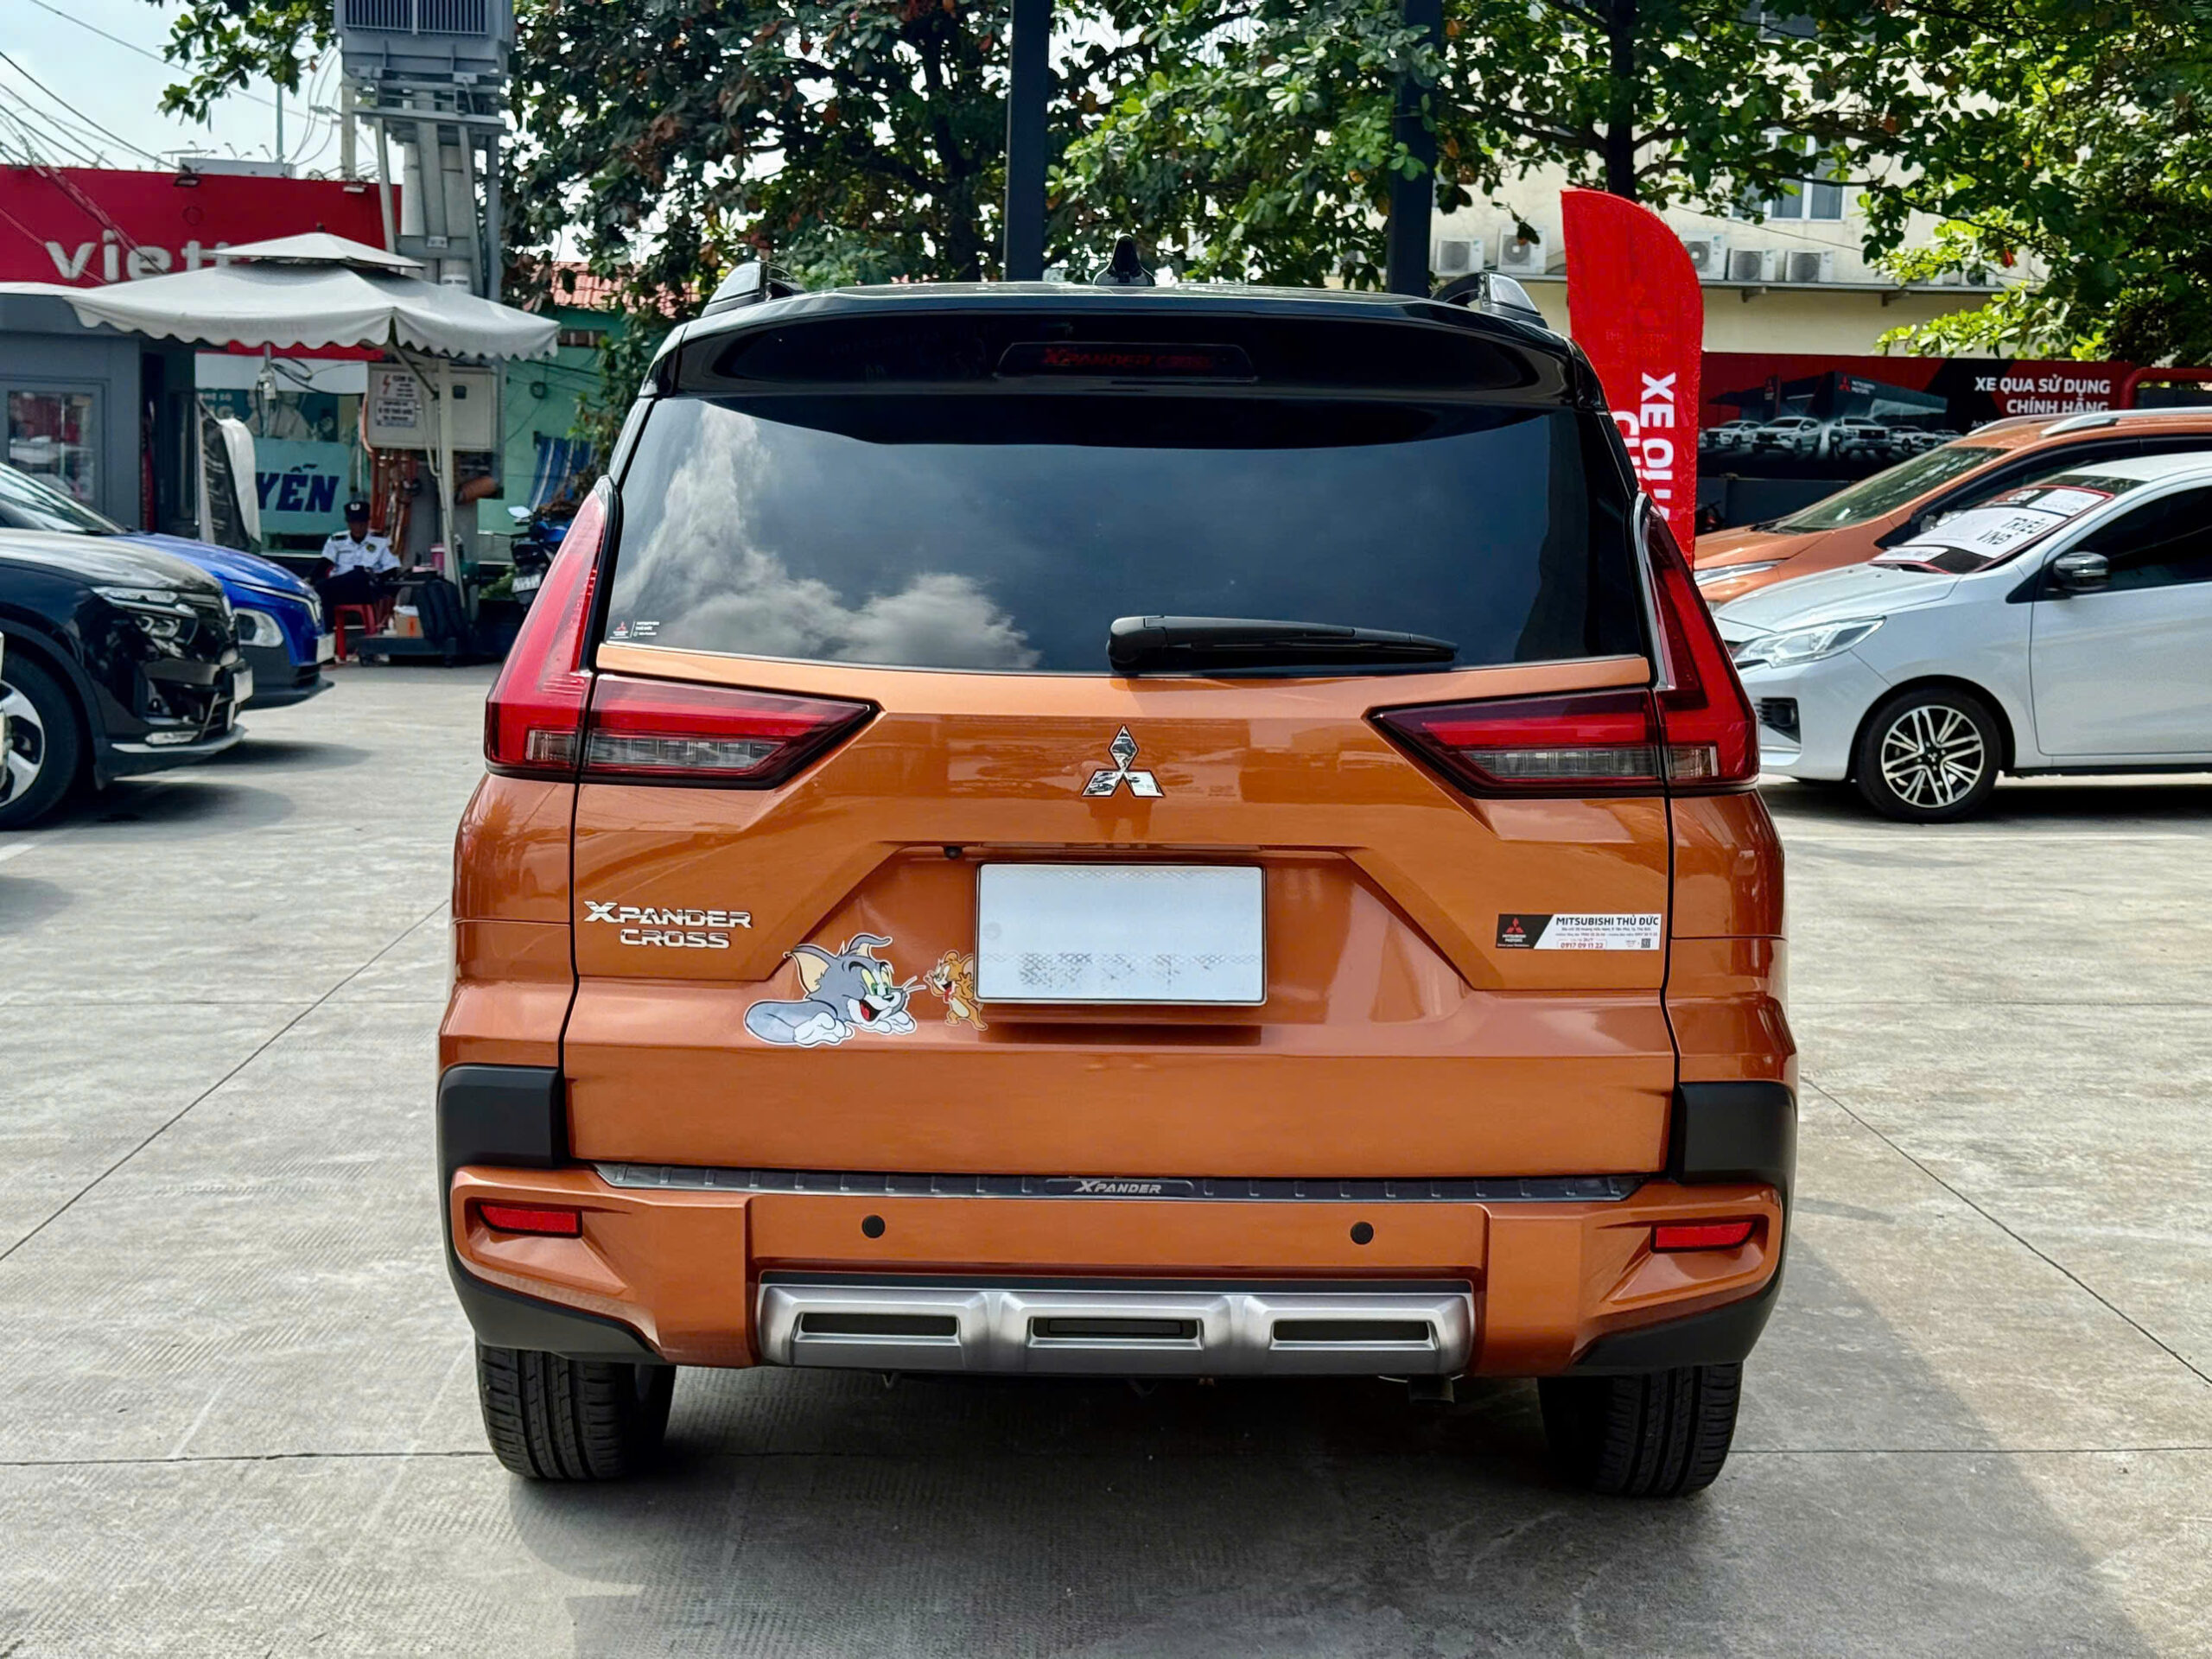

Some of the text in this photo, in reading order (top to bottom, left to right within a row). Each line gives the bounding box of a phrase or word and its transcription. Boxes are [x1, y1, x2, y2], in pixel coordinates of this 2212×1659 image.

[1974, 372, 2112, 398] XE QUA SỬ DỤNG
[1641, 372, 1677, 428] XE
[2005, 396, 2059, 414] CHÍNH
[583, 900, 753, 929] XPANDER
[1555, 917, 1614, 926] MITSUBISHI
[1617, 914, 1637, 926] THỦ
[620, 929, 730, 950] CROSS
[1073, 1180, 1162, 1194] XPANDER
